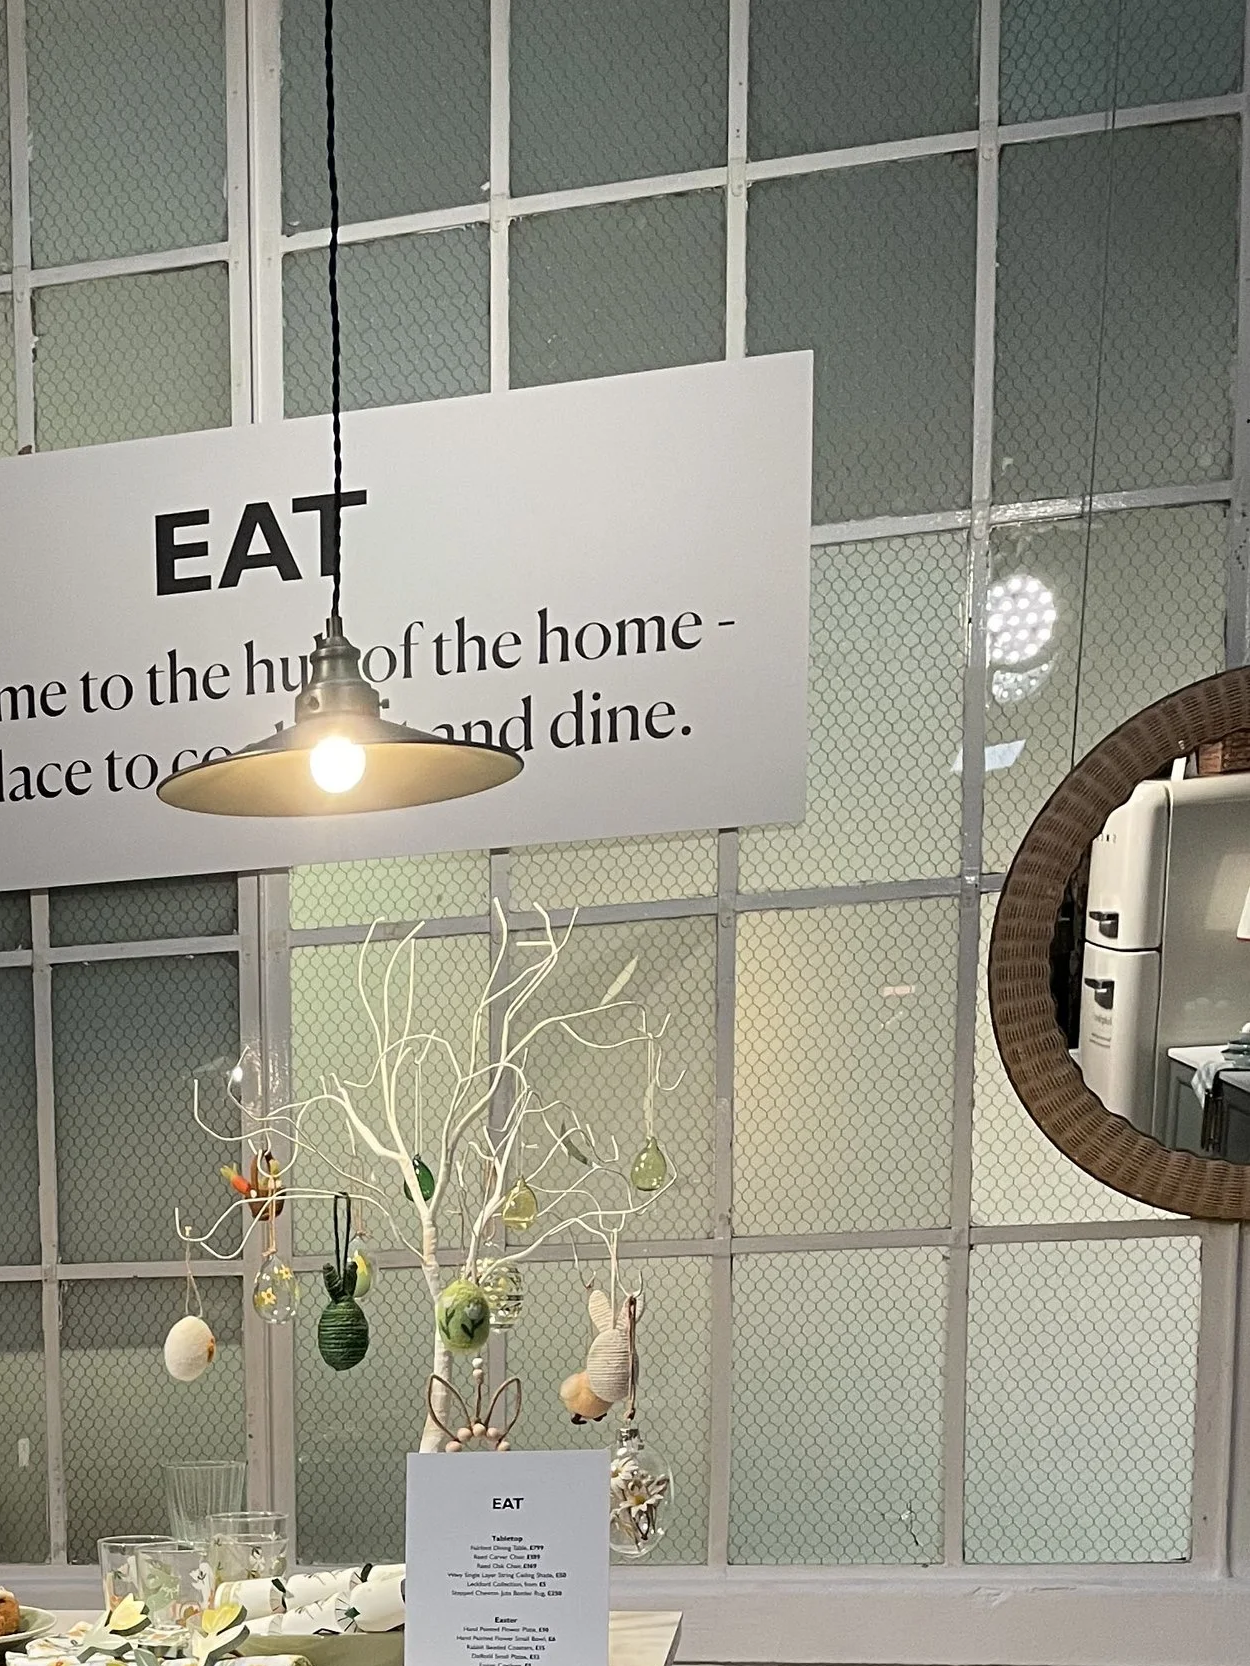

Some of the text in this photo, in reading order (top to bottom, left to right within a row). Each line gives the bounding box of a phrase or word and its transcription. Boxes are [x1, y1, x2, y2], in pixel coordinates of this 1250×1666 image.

[155, 489, 367, 596] EAT
[80, 671, 133, 713] to
[146, 649, 230, 707] the
[244, 632, 325, 696] hu
[362, 621, 424, 683] of
[432, 616, 522, 676] the
[538, 607, 702, 665] home
[105, 750, 159, 792] to
[550, 690, 692, 749] dine.
[492, 1498, 524, 1510] EAT
[464, 1572, 480, 1580] Single
